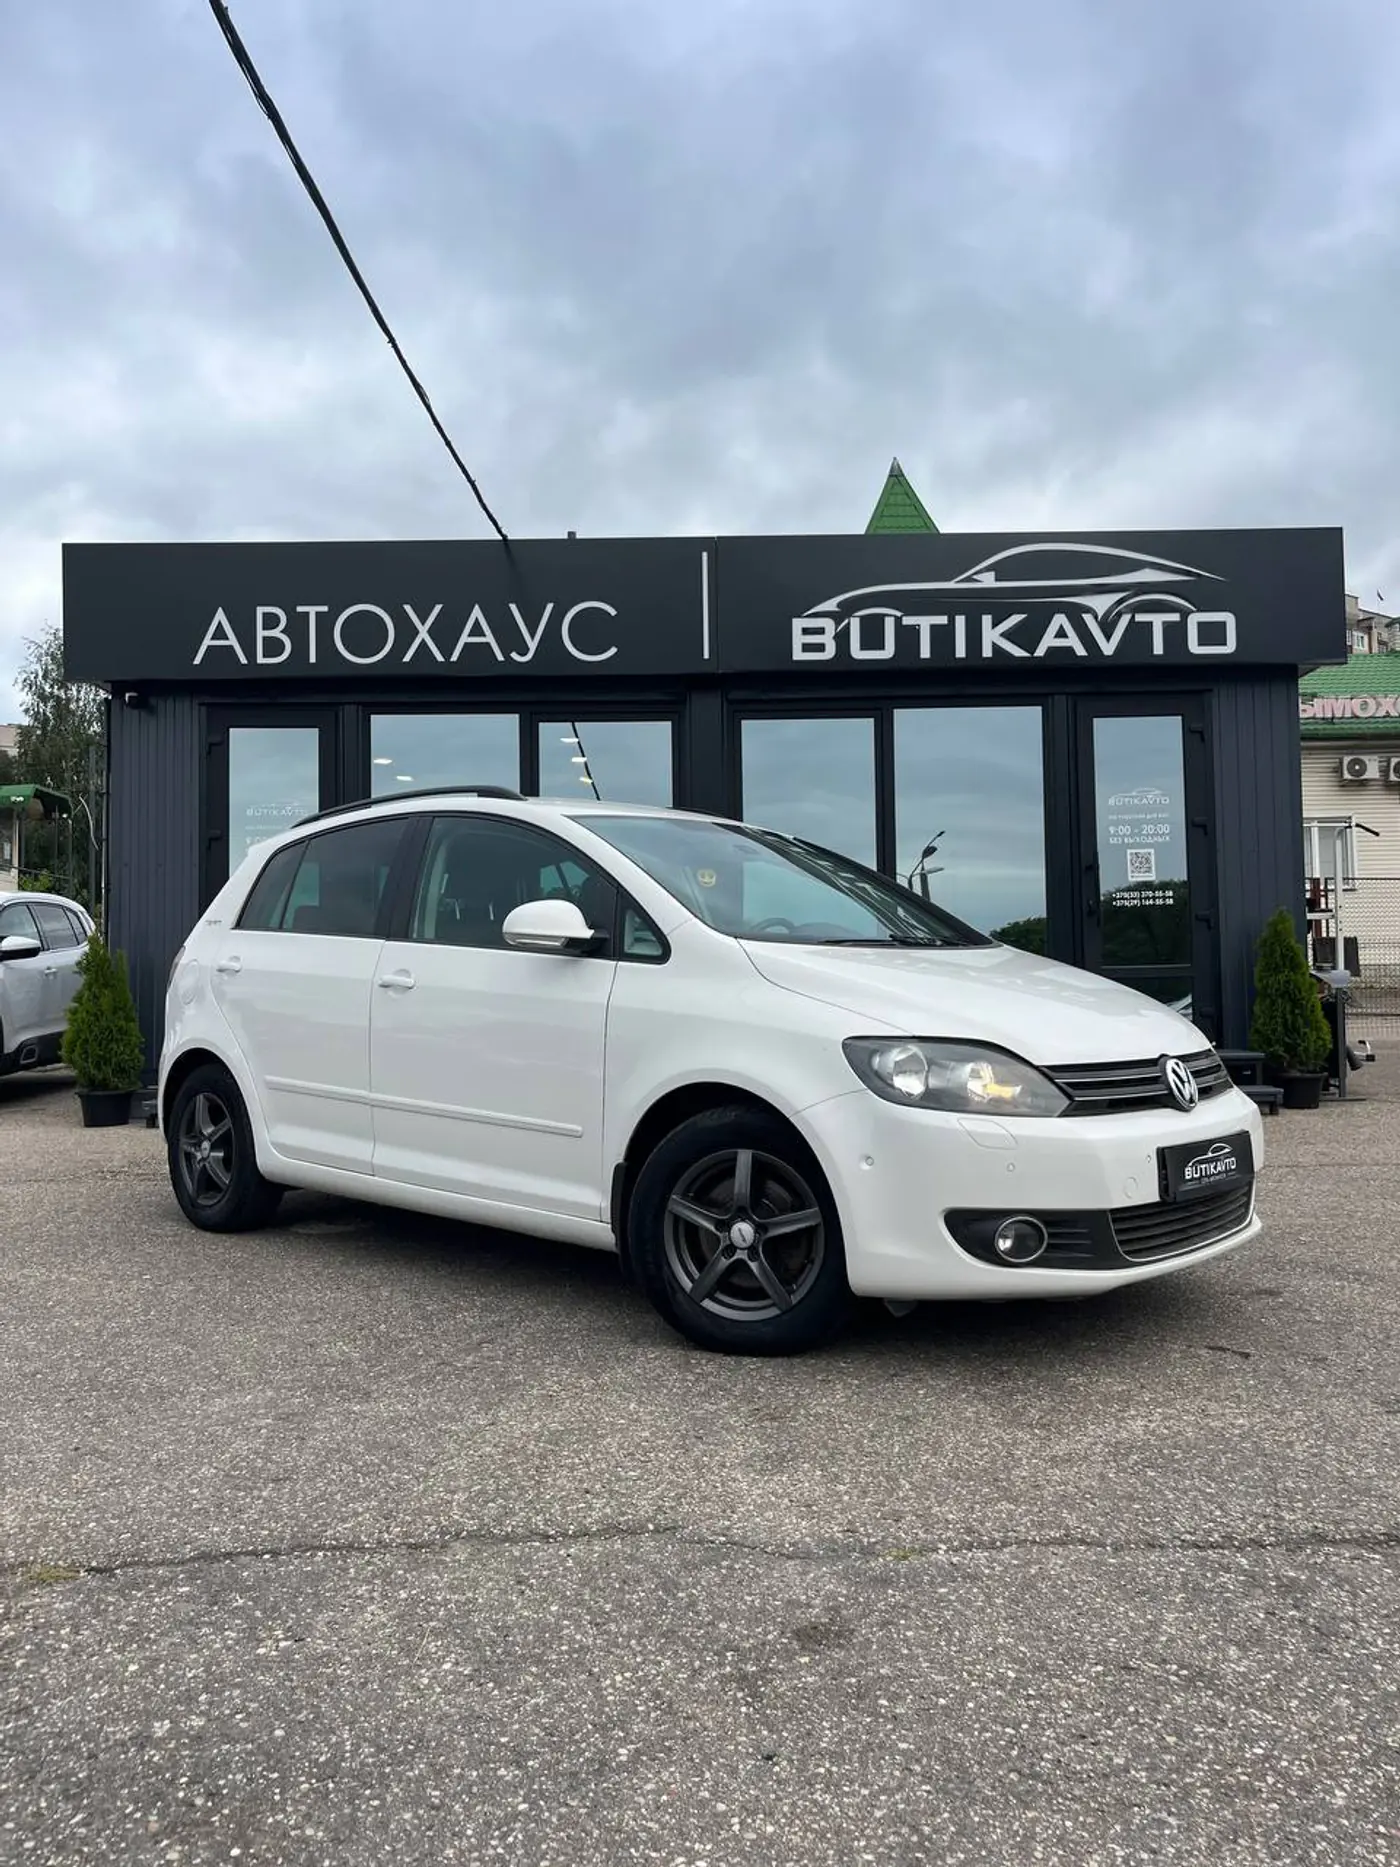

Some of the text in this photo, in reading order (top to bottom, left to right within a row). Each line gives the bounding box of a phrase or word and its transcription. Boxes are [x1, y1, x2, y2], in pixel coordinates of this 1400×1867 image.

[192, 600, 618, 665] АВТОХАУС
[792, 611, 1237, 661] BUTIKAVTO
[1108, 796, 1169, 806] BUTIKAVTO
[1108, 825, 1131, 836] 9:00
[1141, 824, 1169, 834] 20:00
[1184, 1157, 1236, 1180] BUTIKAVTO
